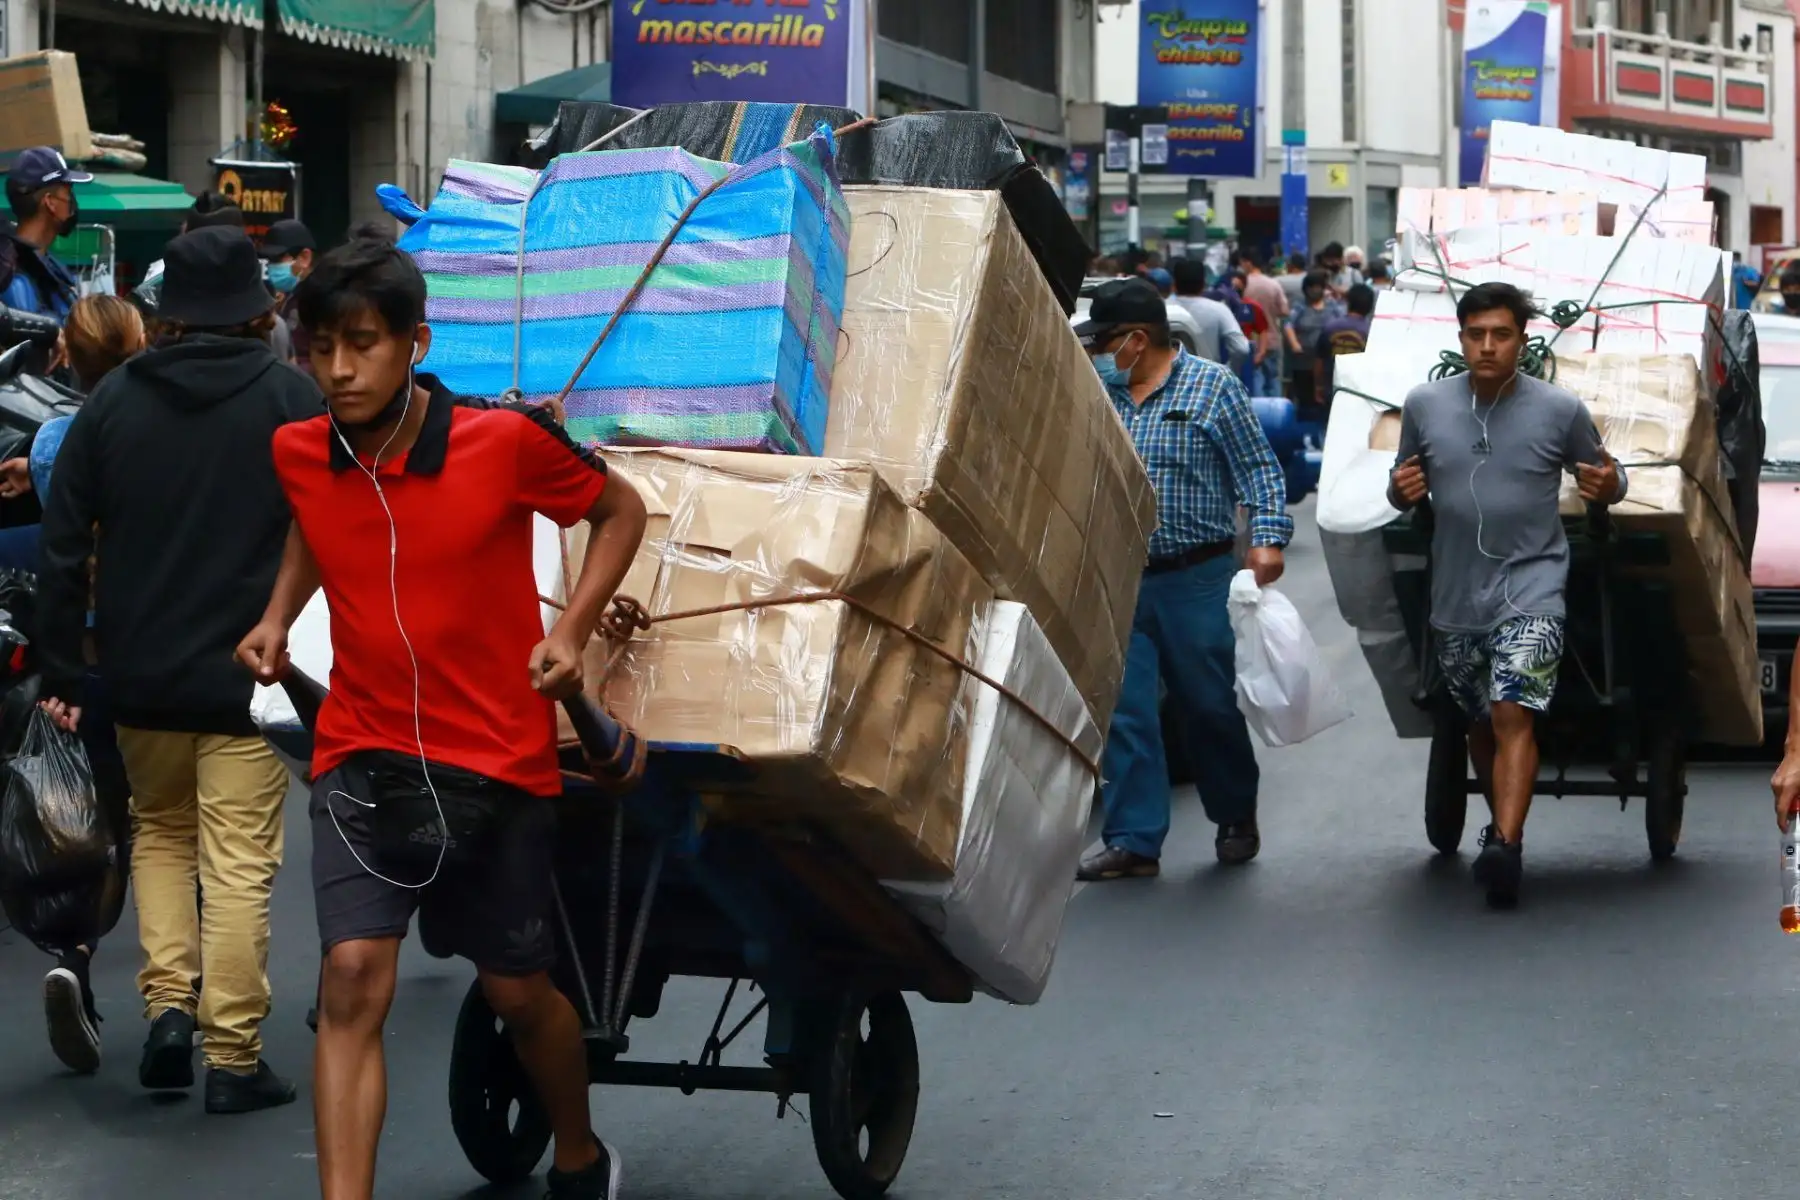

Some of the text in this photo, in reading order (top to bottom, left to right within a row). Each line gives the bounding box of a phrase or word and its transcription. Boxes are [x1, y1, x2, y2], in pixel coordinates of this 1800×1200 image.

[637, 14, 825, 47] mascarilla
[1161, 102, 1239, 120] IEMPRE
[1165, 124, 1244, 141] ascarilla
